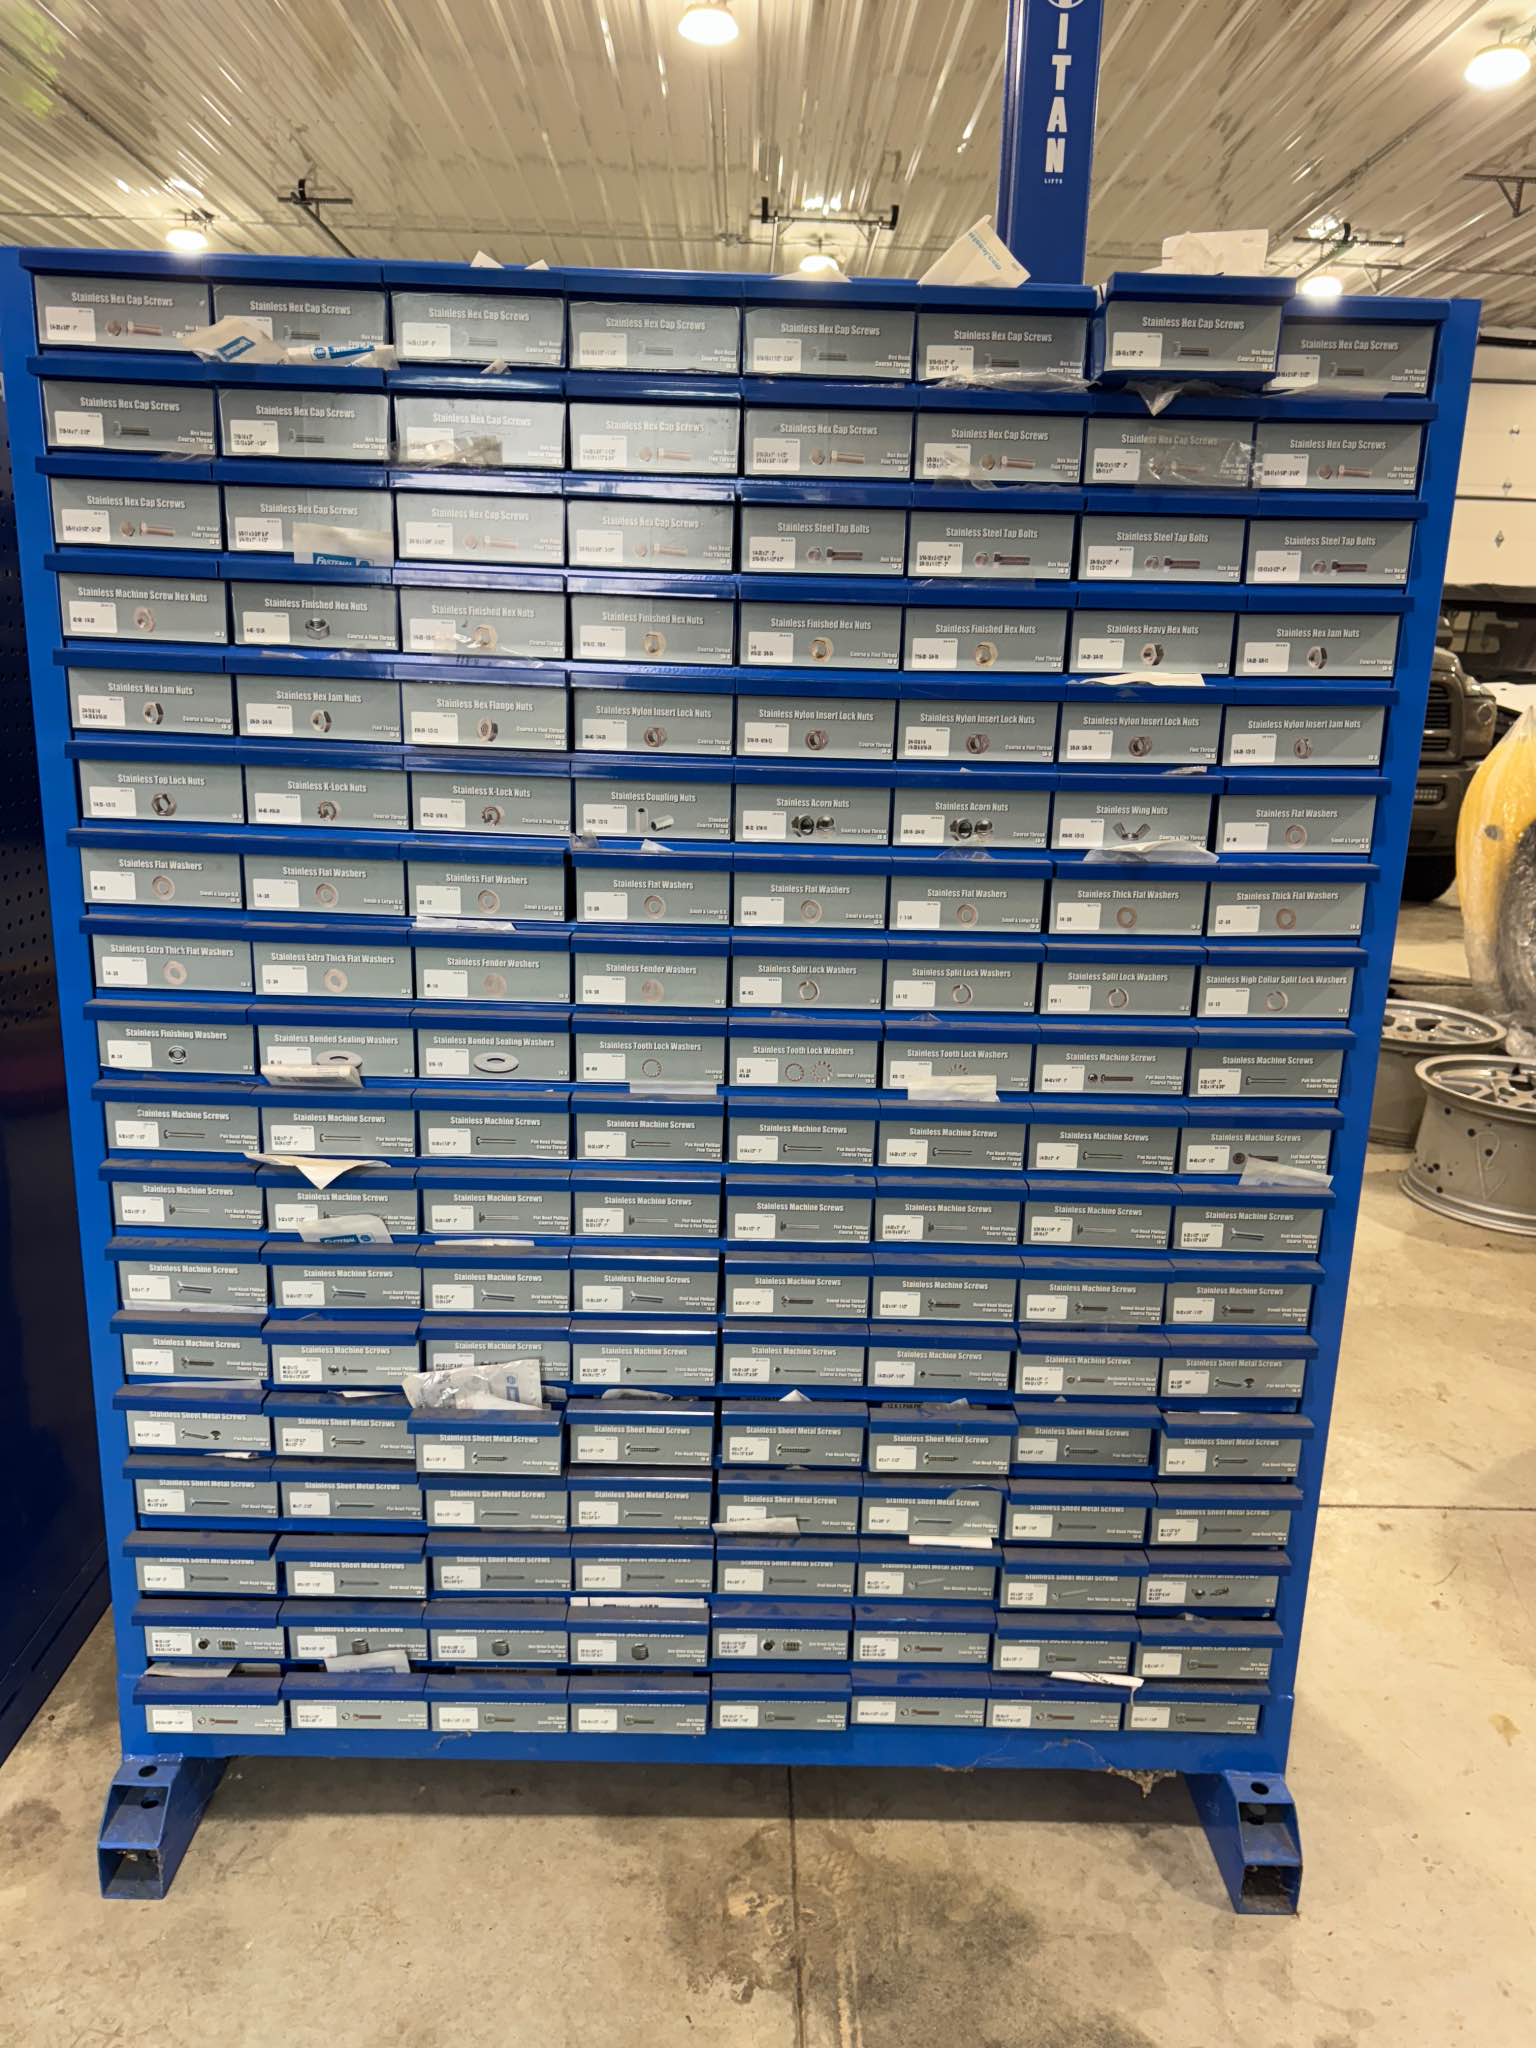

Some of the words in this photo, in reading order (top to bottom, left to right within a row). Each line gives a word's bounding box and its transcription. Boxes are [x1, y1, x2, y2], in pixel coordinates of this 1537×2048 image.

[1045, 0, 1073, 173] ITAN
[70, 292, 109, 303] Stainless
[110, 294, 125, 304] Hex
[126, 295, 142, 306] Cap
[143, 296, 174, 307] Screws
[1141, 317, 1180, 327] Stainless
[1181, 318, 1196, 328] Hex
[1197, 319, 1213, 330] Cap
[1214, 319, 1245, 329] Screws
[780, 324, 817, 334] Stainless
[818, 324, 833, 334] Hex
[834, 325, 849, 336] Cap
[850, 325, 881, 336] Screws
[79, 398, 117, 408] Stainless
[117, 399, 133, 409] Hex
[133, 400, 149, 411] Cap
[150, 401, 181, 411] Screws
[86, 495, 123, 506] Stainless
[124, 497, 138, 507] Hex
[139, 498, 155, 509] Cap
[156, 498, 186, 509] Screws
[776, 523, 813, 533] Stainless
[814, 523, 834, 533] Steel
[835, 523, 848, 534] Tap
[849, 524, 871, 534] Bolts
[1115, 532, 1152, 542] Stainless
[1153, 532, 1173, 542] Steel
[1174, 533, 1187, 544] Tap
[1188, 533, 1209, 543] Bolts
[77, 587, 114, 598] Stainless
[114, 589, 148, 599] Machine
[149, 590, 173, 601] Screw
[174, 592, 189, 602] Hex
[189, 592, 209, 602] Nuts
[263, 598, 300, 609] Stainless
[301, 600, 333, 610] Finished
[334, 601, 349, 611] Hex
[349, 602, 368, 612] Nuts
[1106, 624, 1141, 634] Stainless
[1142, 625, 1165, 636] Heavy
[1166, 625, 1180, 635] Hex
[1181, 626, 1200, 635] Nuts
[107, 683, 143, 693] Stainless
[144, 684, 158, 694] Hex
[159, 685, 174, 695] Jam
[175, 686, 194, 696] Nuts
[436, 699, 472, 709] Stainless
[473, 700, 487, 710] Hex
[488, 701, 514, 712] Flange
[515, 702, 534, 712] Nuts
[758, 709, 793, 719] Stainless
[793, 710, 814, 721] Nylon
[815, 710, 838, 720] Insert
[838, 711, 855, 721] Lock
[856, 712, 875, 722] Nuts
[1247, 719, 1282, 729] Stainless
[1283, 720, 1304, 730] Nylon
[1305, 719, 1327, 729] Insert
[1328, 719, 1343, 729] Jam
[1344, 720, 1362, 729] Nuts
[287, 780, 322, 791] Stainless
[349, 782, 368, 792] Nuts
[610, 791, 644, 802] Stainless
[645, 792, 678, 804] Coupling
[679, 793, 697, 803] Nuts
[775, 798, 809, 808] Stainless
[810, 798, 832, 808] Acorn
[832, 799, 850, 809] Nuts
[1255, 808, 1289, 818] Stainless
[1290, 809, 1304, 818] Flat
[1305, 809, 1339, 818] Washers
[118, 859, 153, 869] Stainless
[154, 860, 168, 870] Flat
[168, 860, 203, 871] Washers
[769, 884, 803, 894] Stainless
[804, 884, 817, 894] Flat
[818, 884, 851, 894] Washers
[1236, 891, 1270, 901] Stainless
[1271, 891, 1291, 901] Thick
[1292, 891, 1305, 901] Flat
[1306, 891, 1339, 901] Washers
[109, 944, 144, 954] Stainless
[145, 945, 164, 955] Extra
[164, 946, 185, 956] Thick
[185, 946, 199, 956] Flat
[200, 947, 235, 958] Washers
[446, 958, 480, 967] Stainless
[507, 960, 540, 969] Washers
[757, 965, 790, 974] Stainless
[791, 965, 808, 975] Split
[808, 965, 824, 974] Lock
[825, 966, 857, 975] Washers
[1205, 975, 1239, 984] Stainless
[1280, 976, 1297, 986] Split
[1298, 976, 1314, 985] Lock
[1315, 976, 1348, 985] Washers
[124, 1028, 159, 1038] Stainless
[160, 1029, 193, 1040] Finishing
[194, 1030, 228, 1041] Washers
[273, 1033, 308, 1043] Stainless
[366, 1036, 399, 1046] Washers
[599, 1041, 632, 1050] Stainless
[632, 1041, 652, 1050] Tooth
[653, 1042, 669, 1051] Lock
[670, 1042, 702, 1051] Washers
[1065, 1053, 1098, 1062] Stainless
[1099, 1053, 1129, 1062] Machine
[1130, 1054, 1157, 1063] Screws
[449, 1116, 482, 1125] Stainless
[483, 1117, 513, 1126] Machine
[514, 1118, 542, 1127] Screws
[756, 1202, 788, 1211] Stainless
[789, 1203, 818, 1212] Machine
[818, 1203, 845, 1212] Screws
[1204, 1211, 1237, 1220] Stainless
[1237, 1212, 1267, 1221] Machine
[1268, 1212, 1295, 1222] Screws
